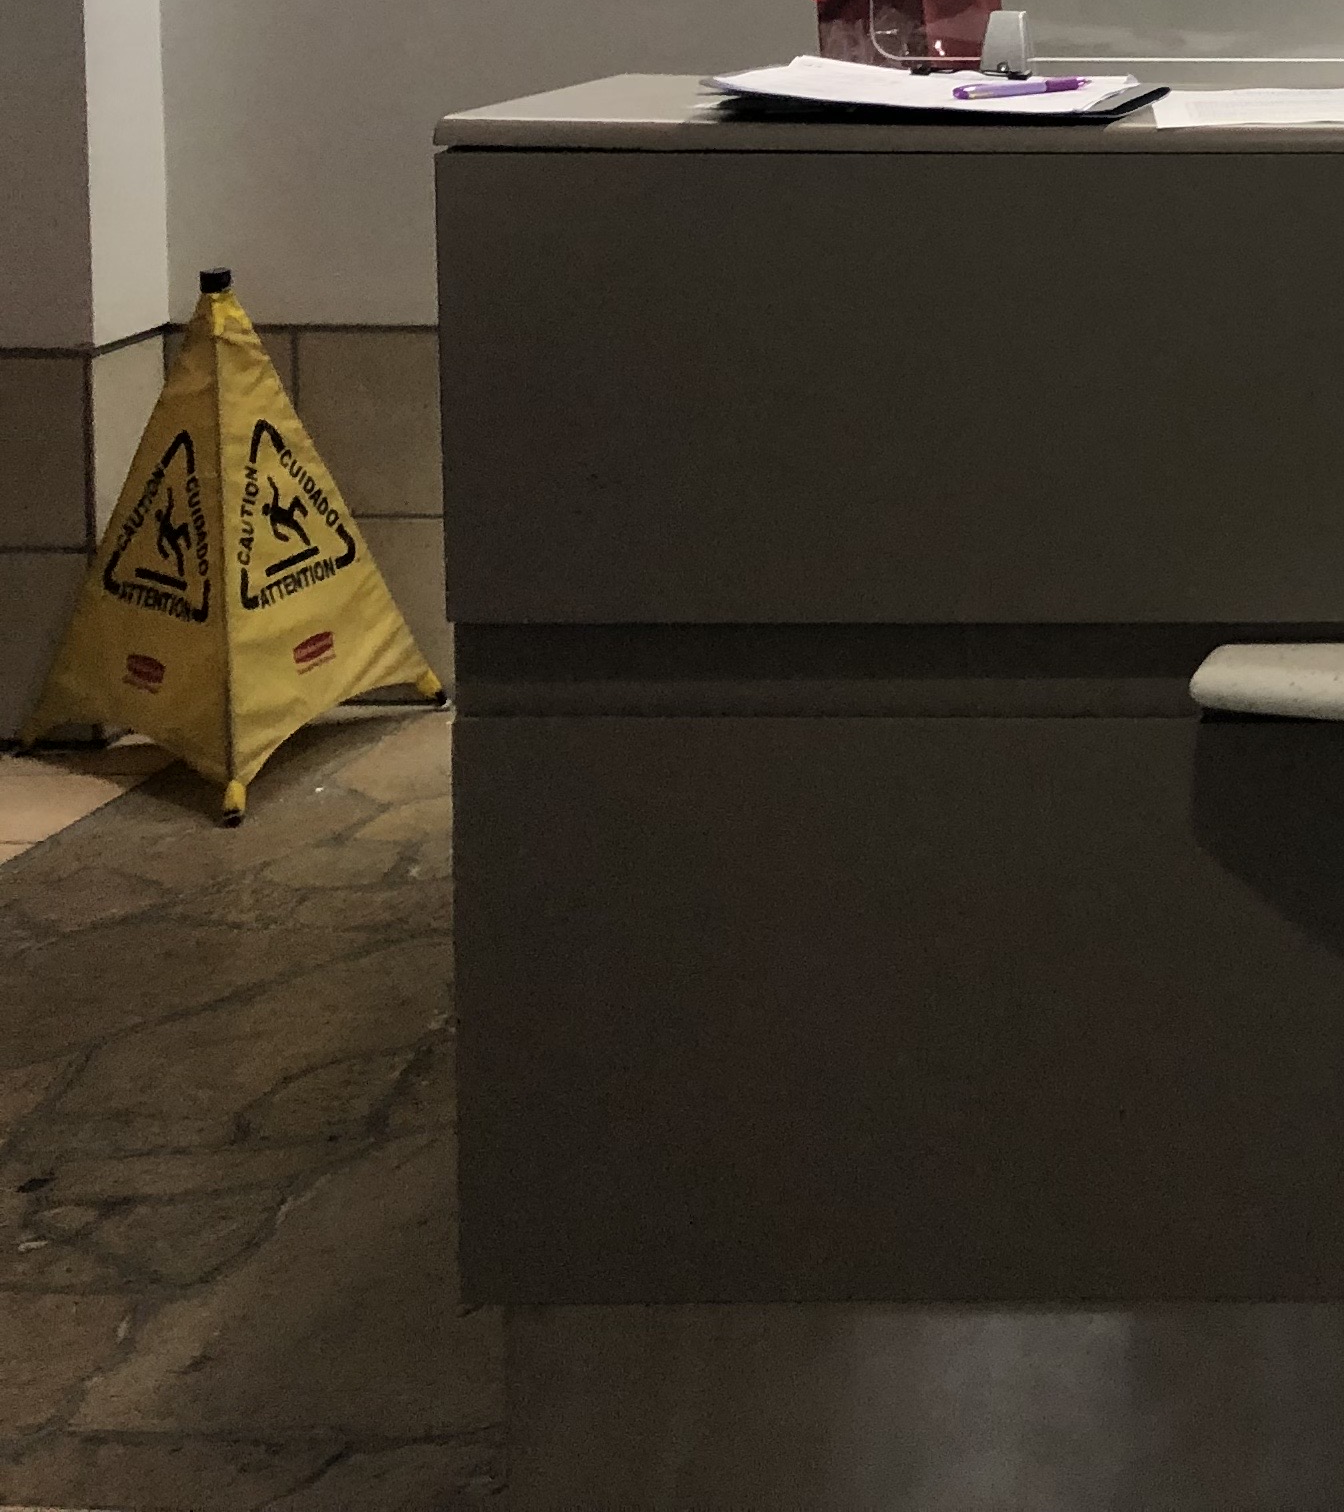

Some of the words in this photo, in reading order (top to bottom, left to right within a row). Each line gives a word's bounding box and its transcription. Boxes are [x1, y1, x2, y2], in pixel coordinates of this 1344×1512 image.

[236, 465, 259, 566] CAUTION
[280, 448, 340, 529] CUIDADO
[259, 556, 337, 609] ATTENTION
